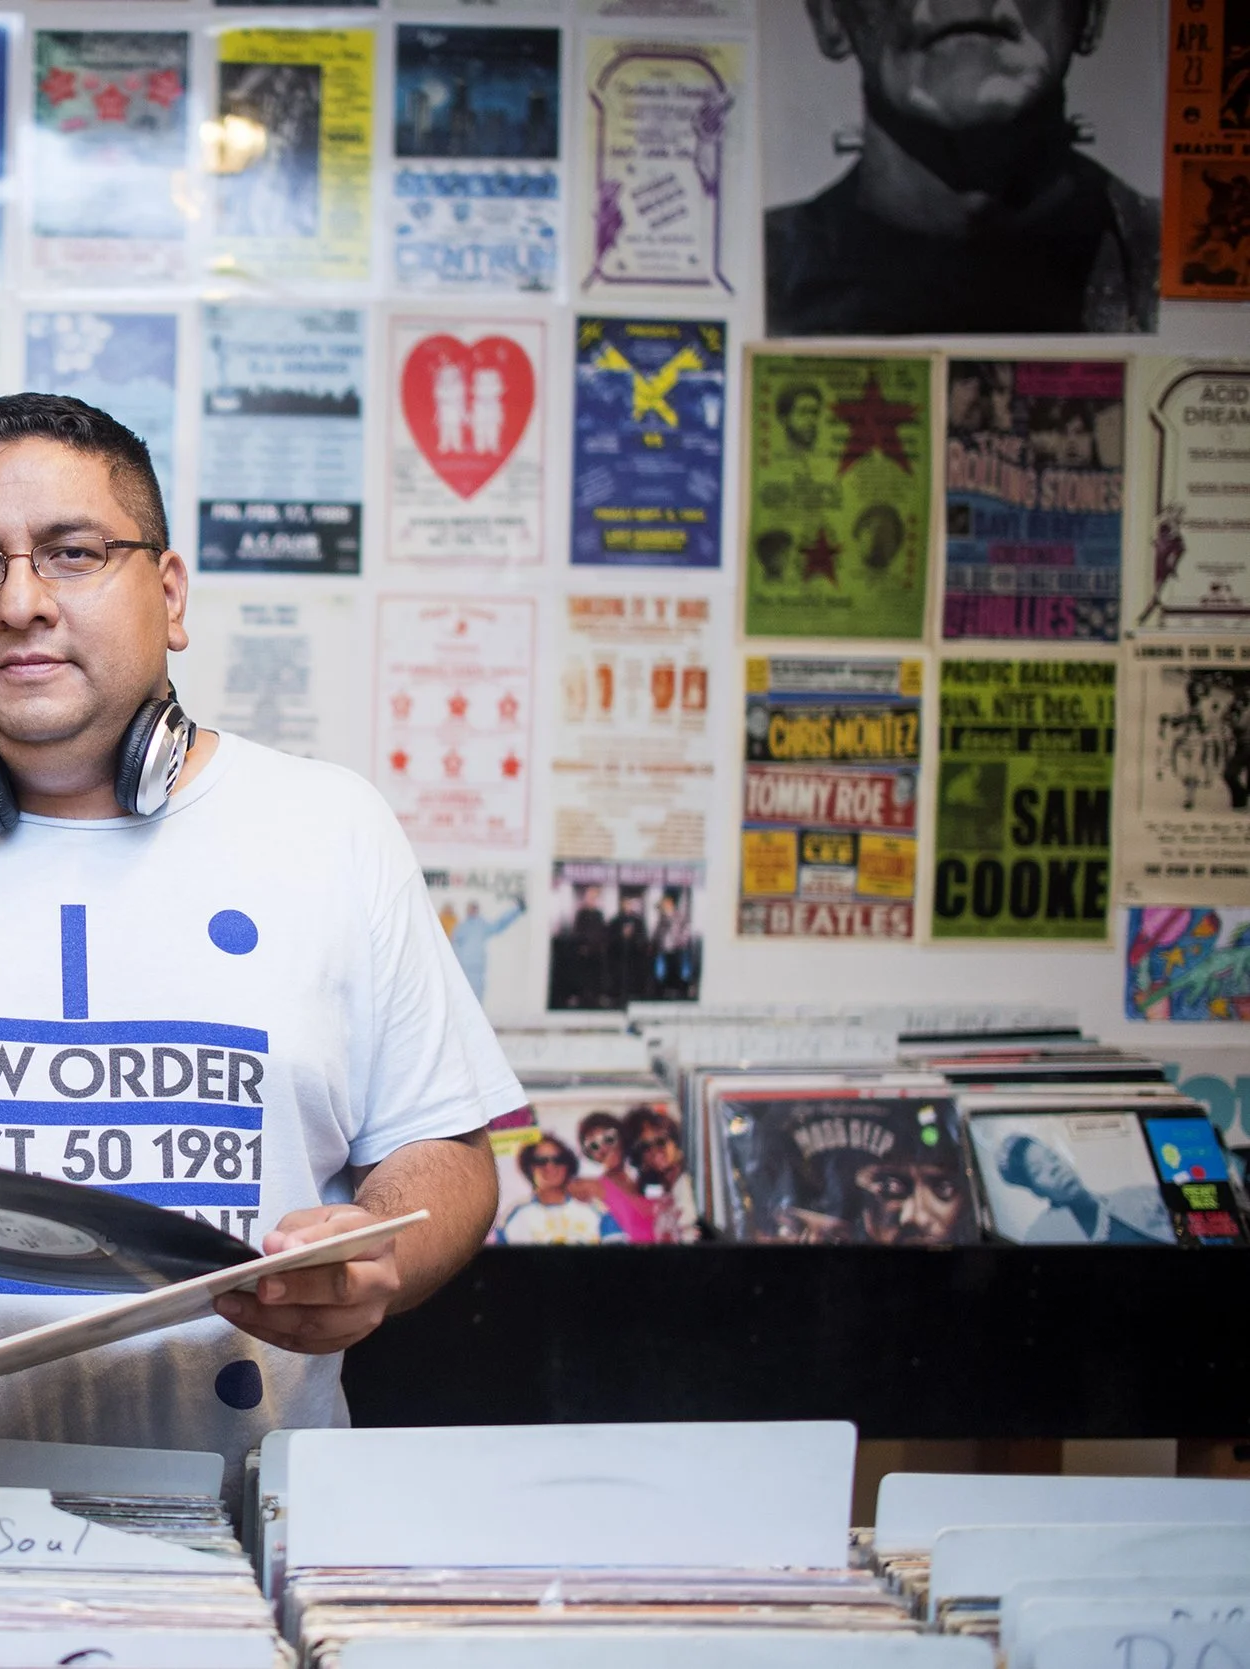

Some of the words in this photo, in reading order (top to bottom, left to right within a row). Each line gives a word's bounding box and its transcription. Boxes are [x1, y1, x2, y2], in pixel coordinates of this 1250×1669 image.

[941, 661, 1013, 683] PACIFIC
[1018, 662, 1116, 685] BALLROOM
[940, 696, 983, 719] SUN.
[768, 714, 831, 758] CHRIS
[833, 714, 919, 757] MONTEZ
[748, 773, 832, 818] TOMMY
[833, 780, 886, 825] ROE
[1011, 787, 1110, 848] SAM
[935, 857, 1108, 920] COOKE
[770, 902, 913, 938] BEATLES
[48, 1047, 265, 1104] ORDER
[61, 1129, 133, 1181] 50
[151, 1128, 263, 1181] 1981
